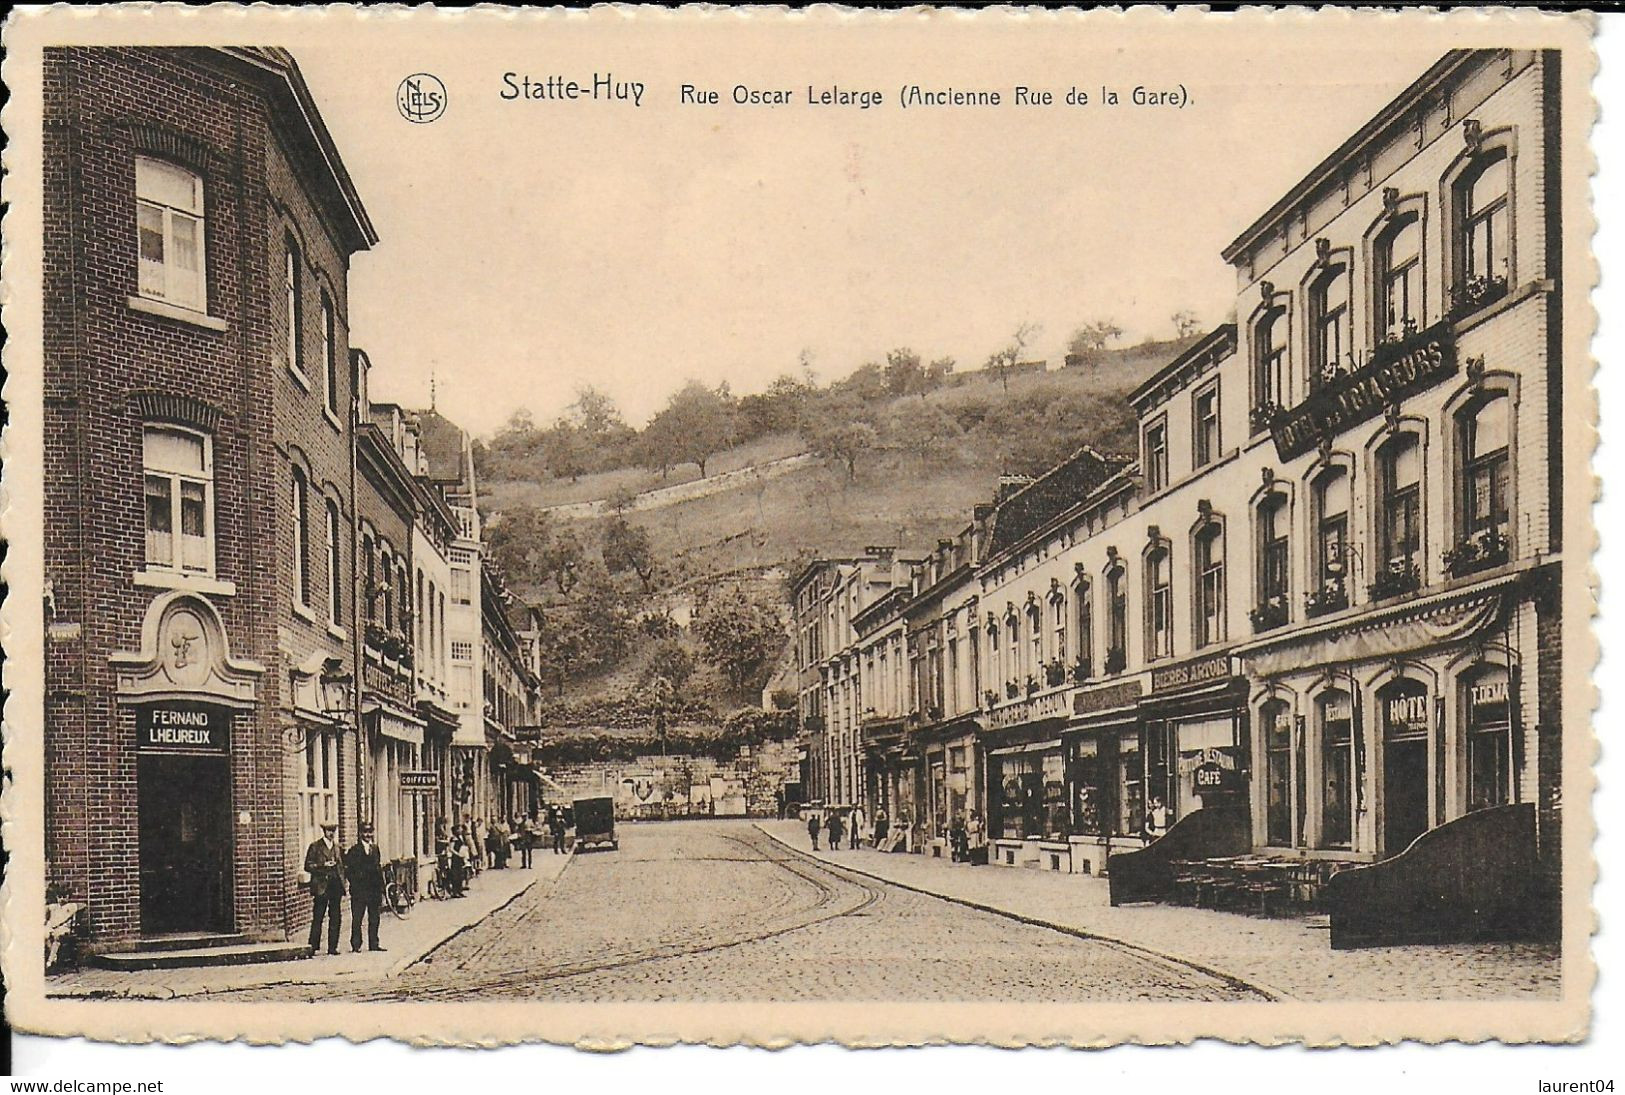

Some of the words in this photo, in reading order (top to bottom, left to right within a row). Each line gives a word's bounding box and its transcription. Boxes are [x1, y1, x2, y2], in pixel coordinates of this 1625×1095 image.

[1190, 656, 1228, 682] ARTOIS
[1389, 692, 1425, 725] HÔTE
[153, 709, 208, 727] FERNAND
[149, 728, 210, 745] LHEUREUX
[401, 775, 437, 785] COIFFEUR
